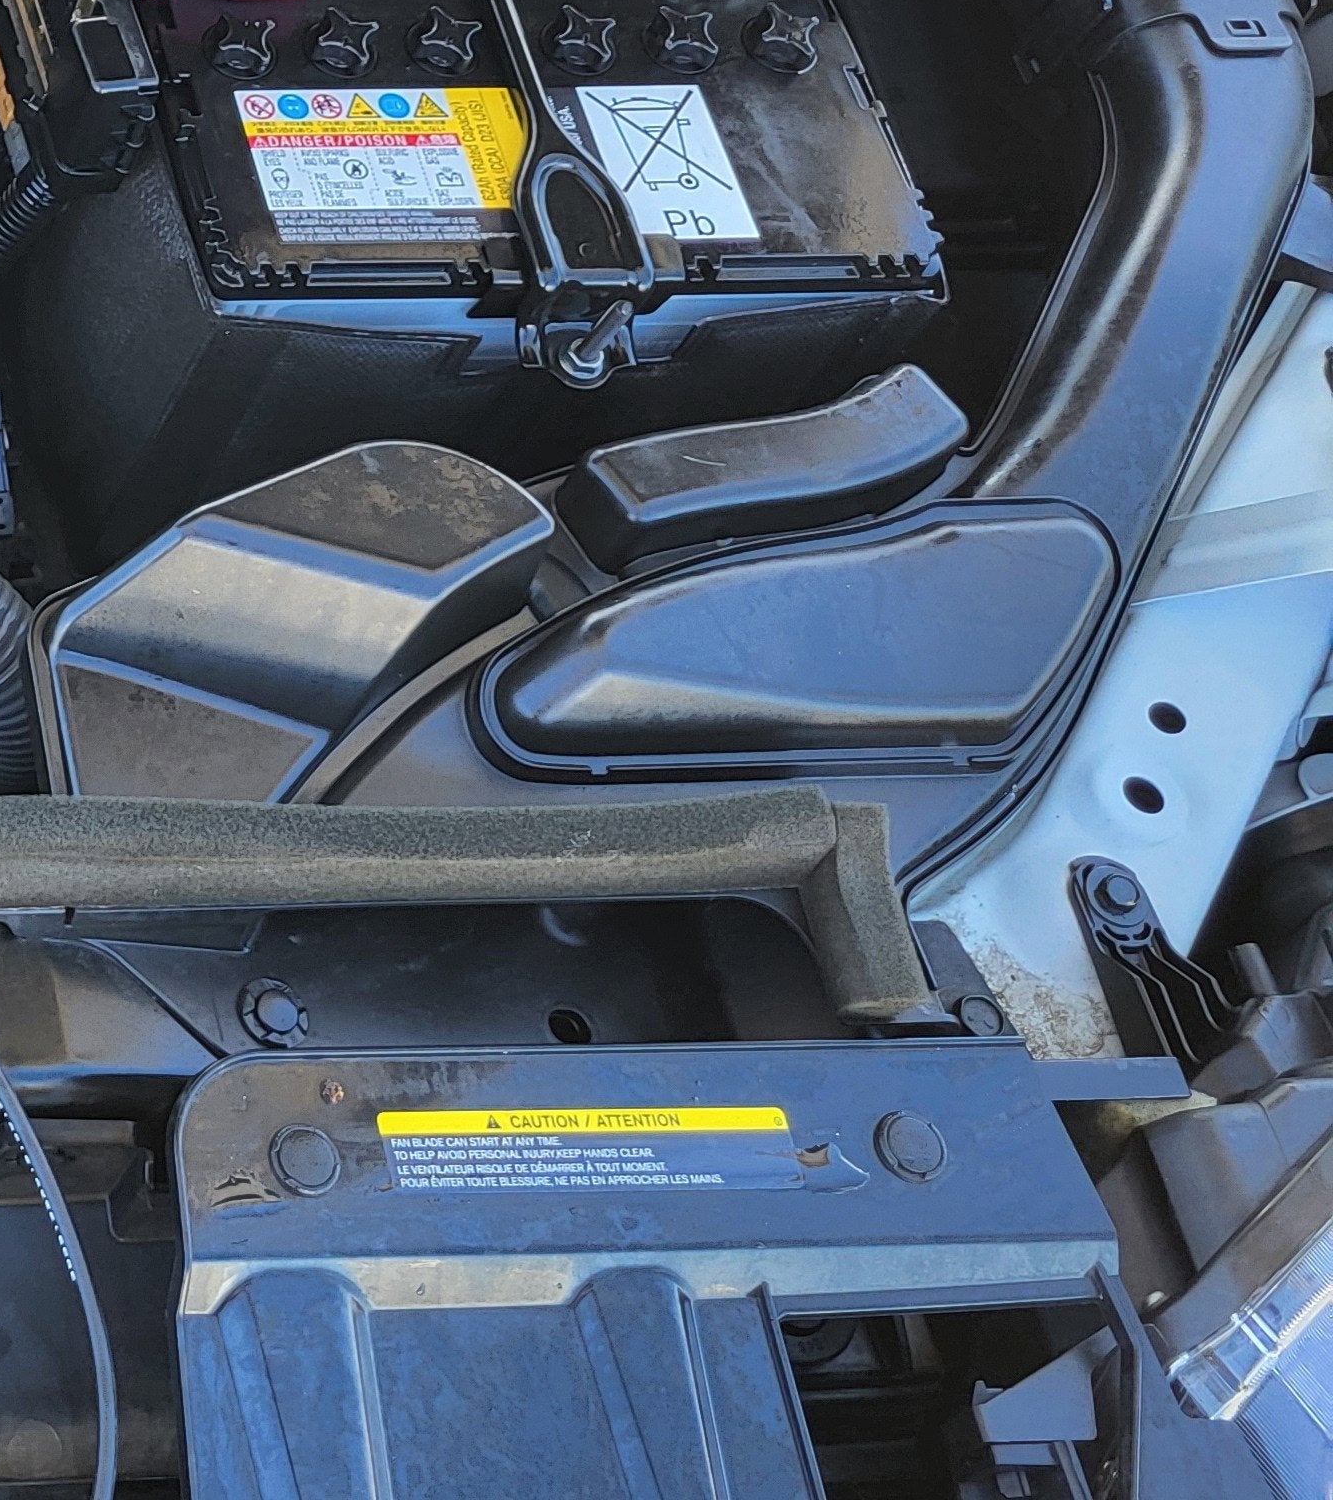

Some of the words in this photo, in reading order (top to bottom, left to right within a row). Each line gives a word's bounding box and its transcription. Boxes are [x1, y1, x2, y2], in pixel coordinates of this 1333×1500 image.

[267, 135, 408, 147] DANGER/POISON
[662, 208, 716, 238] Pb
[509, 1115, 582, 1129] CAUTION
[585, 1114, 591, 1129] /
[596, 1113, 681, 1128] ATTENTION
[391, 1138, 411, 1148] FAN
[412, 1138, 444, 1147] BLADE
[445, 1137, 469, 1147] CAN
[469, 1137, 500, 1147] START
[501, 1137, 513, 1146] AT
[515, 1137, 535, 1146] ANY
[536, 1136, 563, 1146] TIME.
[393, 1151, 408, 1161] TO
[409, 1151, 435, 1160] HELP
[437, 1151, 467, 1160] AVOID
[468, 1150, 521, 1160] PERSONAL
[583, 1148, 619, 1158] HANDS
[619, 1148, 655, 1158] CLEAR.
[397, 1165, 410, 1175] LE
[411, 1164, 475, 1175] VENTILATEUR
[476, 1164, 513, 1174] RISQUE
[514, 1164, 529, 1173] DE
[530, 1160, 583, 1173] DÉMARRER
[595, 1163, 620, 1172] TOUT
[621, 1162, 669, 1172] MOMENT.
[400, 1178, 429, 1188] POUR
[430, 1175, 464, 1187] ÉVITER
[465, 1178, 499, 1187] TOUTE
[500, 1177, 554, 1187] BLESSURE,
[555, 1177, 570, 1186] NE
[570, 1176, 590, 1186] PAS
[591, 1176, 606, 1185] EN
[607, 1175, 669, 1185] APPROCHER
[670, 1174, 690, 1184] LES
